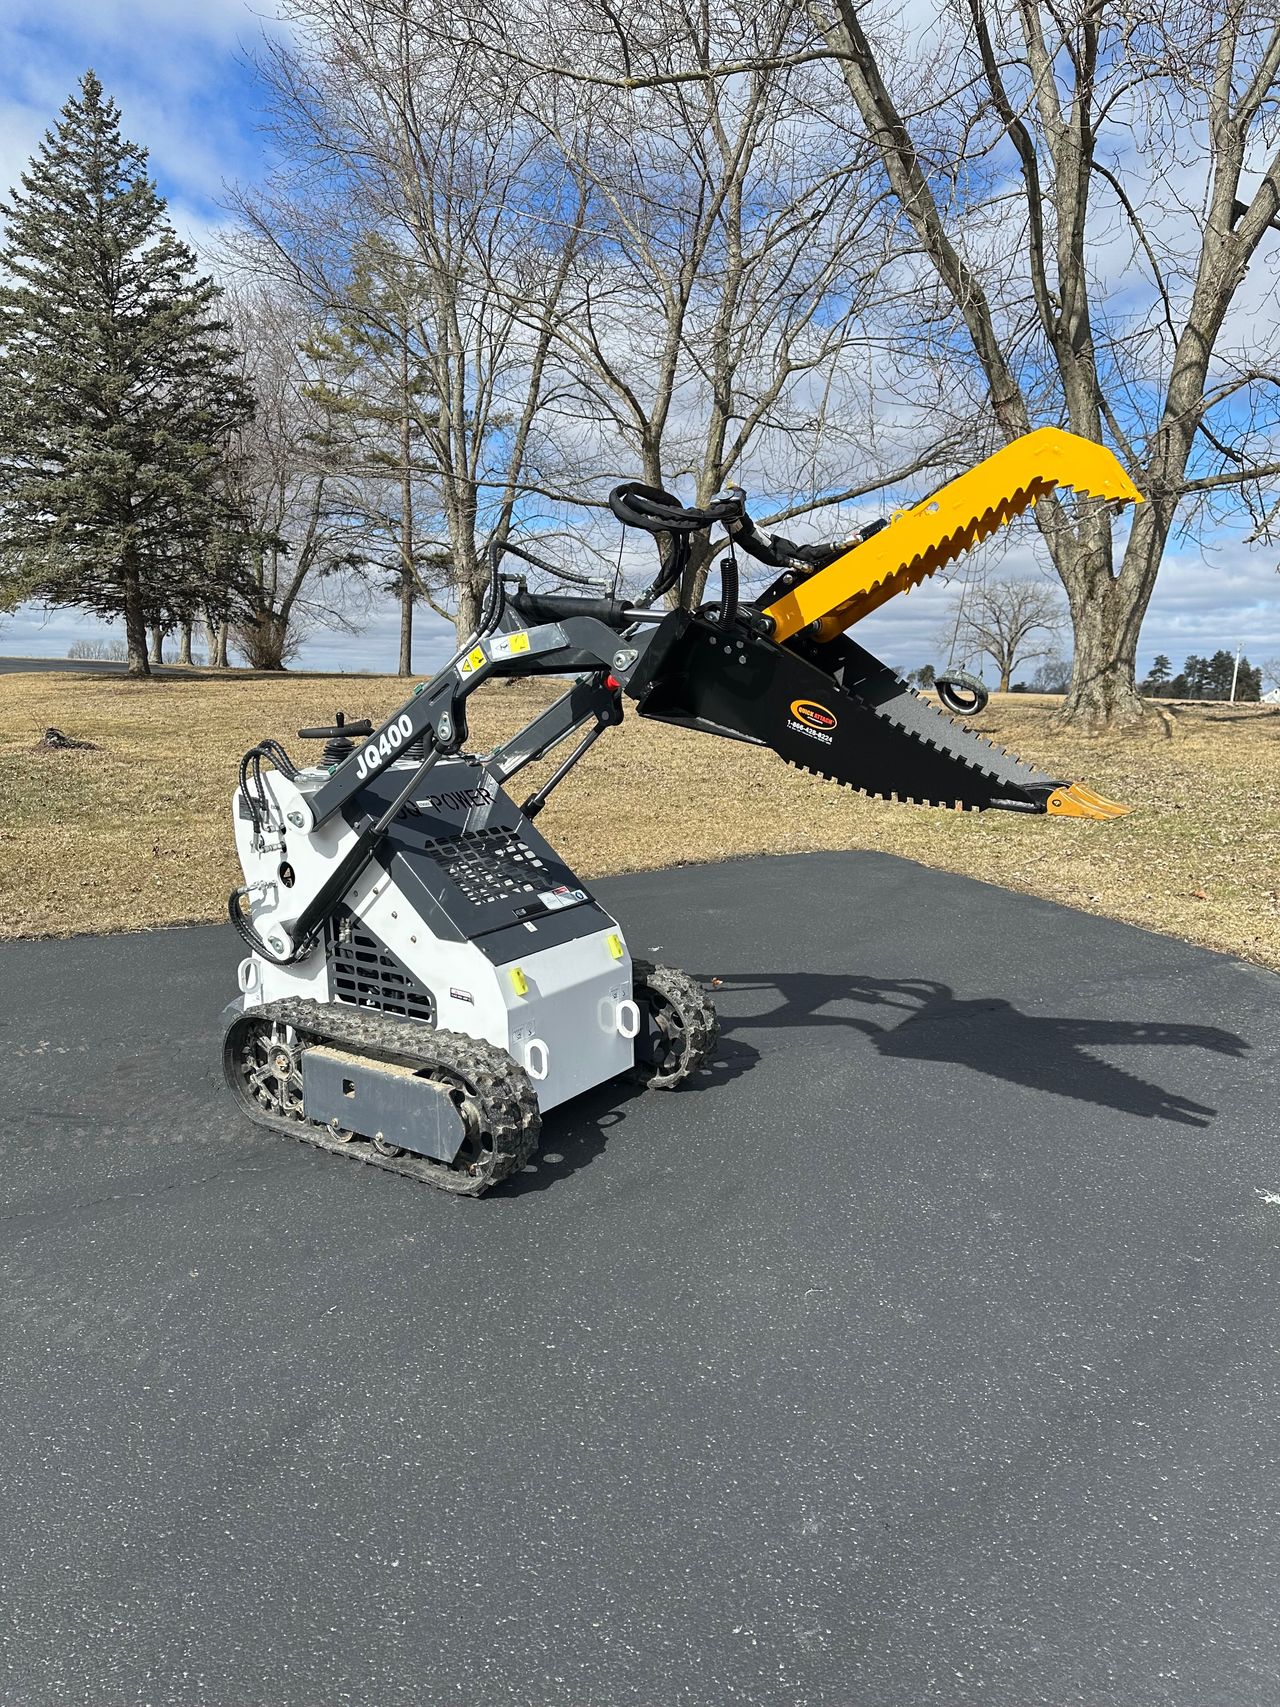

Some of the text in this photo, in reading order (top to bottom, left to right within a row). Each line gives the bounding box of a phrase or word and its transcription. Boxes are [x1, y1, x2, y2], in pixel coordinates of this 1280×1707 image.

[799, 707, 814, 717] QUICK
[814, 713, 832, 724] ATTACH
[356, 714, 413, 780] JQ400
[427, 787, 497, 813] POWER
